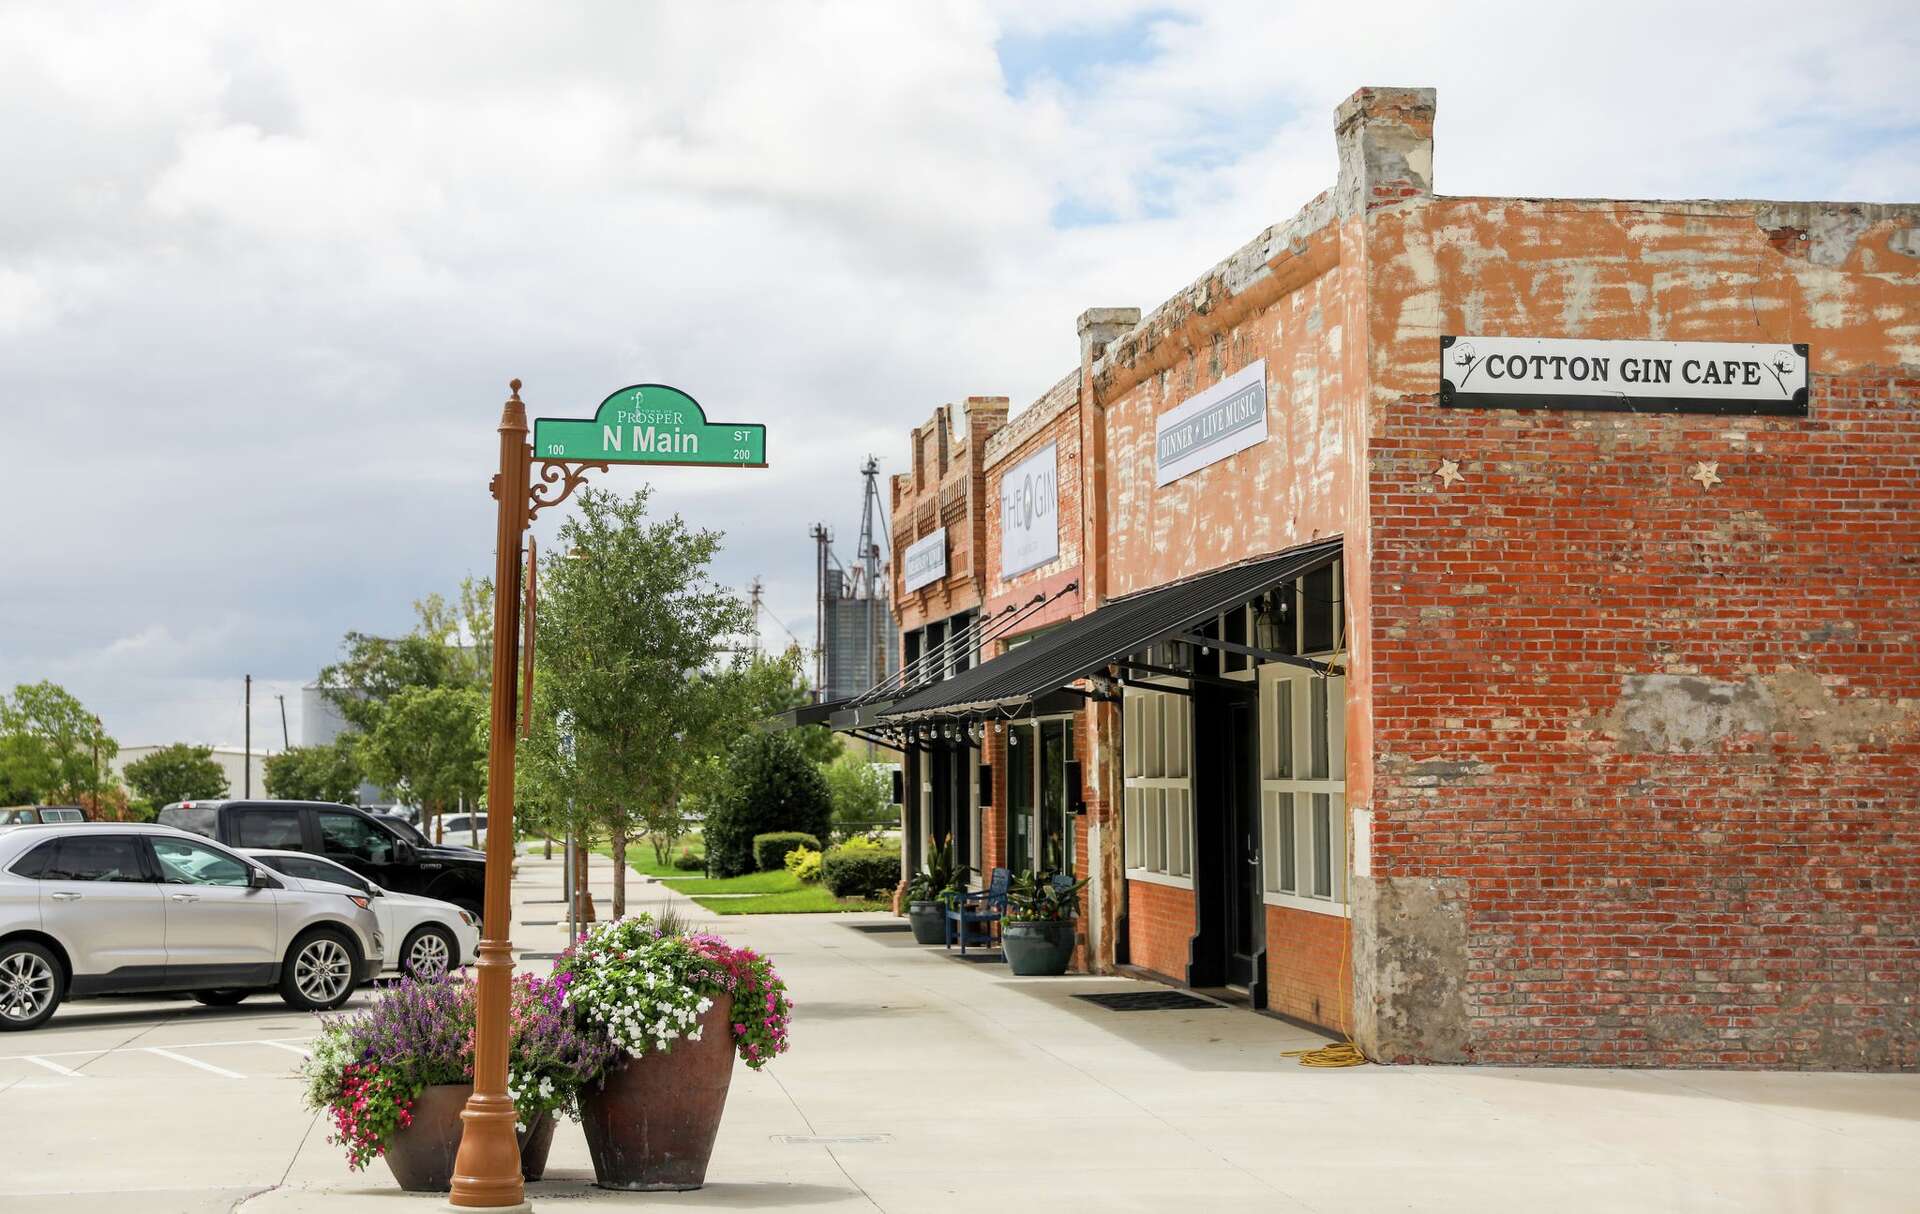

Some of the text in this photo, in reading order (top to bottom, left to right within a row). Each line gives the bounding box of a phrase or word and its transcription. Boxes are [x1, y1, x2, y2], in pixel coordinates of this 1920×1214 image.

[1485, 354, 1762, 386] COTTON GIN CAFE
[617, 410, 684, 425] PROSPER
[1161, 391, 1258, 459] DINNER LIVE MUSIC
[603, 425, 699, 454] N Main
[734, 430, 751, 442] ST
[547, 444, 565, 456] 100
[733, 449, 750, 461] 200
[1002, 467, 1056, 534] THE GIN
